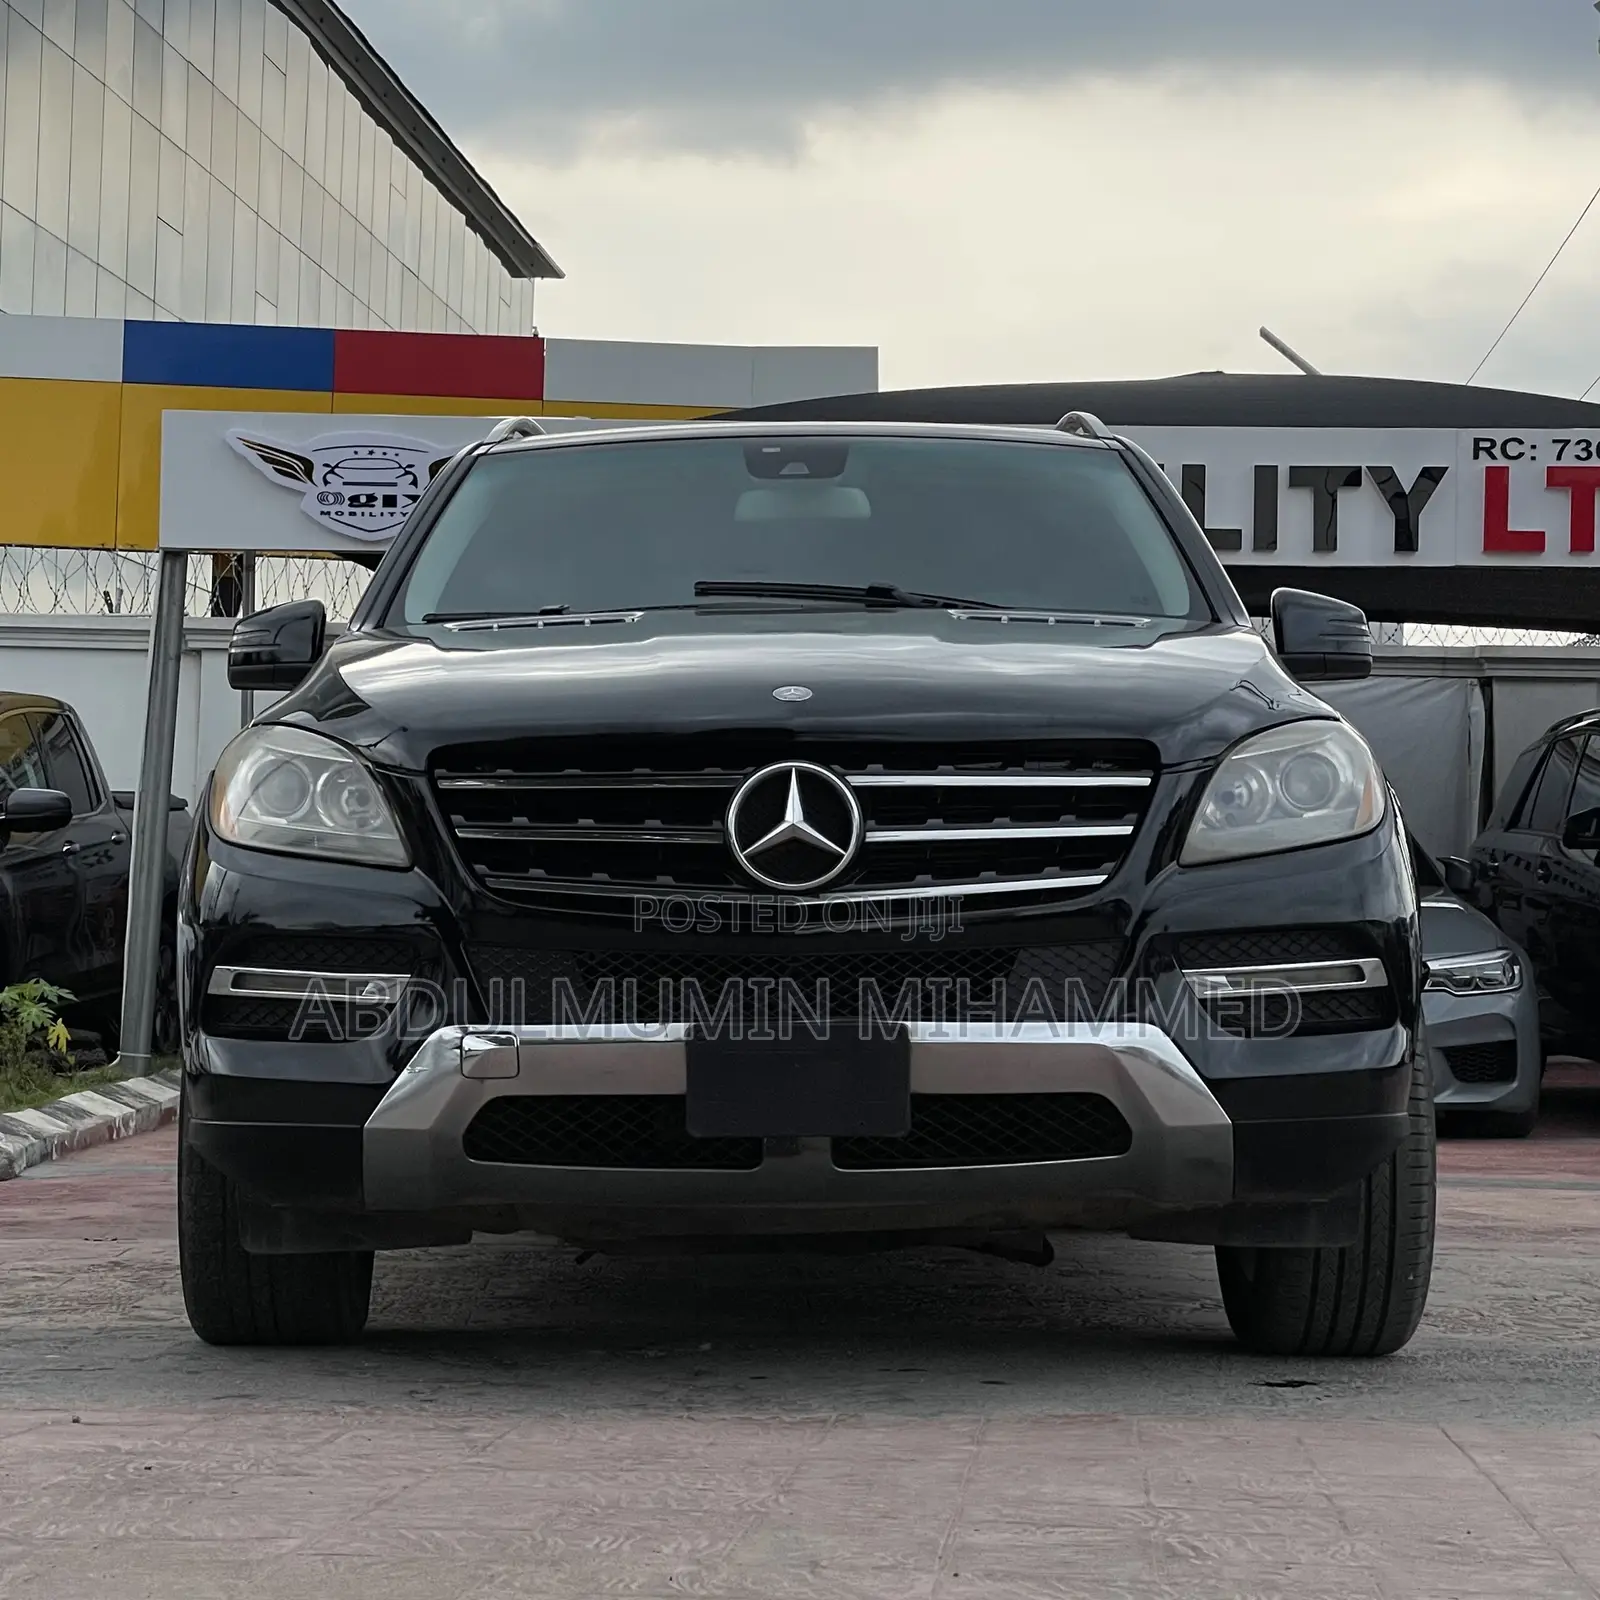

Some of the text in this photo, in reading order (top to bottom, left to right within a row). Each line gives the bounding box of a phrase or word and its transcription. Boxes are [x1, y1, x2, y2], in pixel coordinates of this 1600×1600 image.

[1472, 437, 1600, 461] RC: 73
[1157, 464, 1449, 552] LITY
